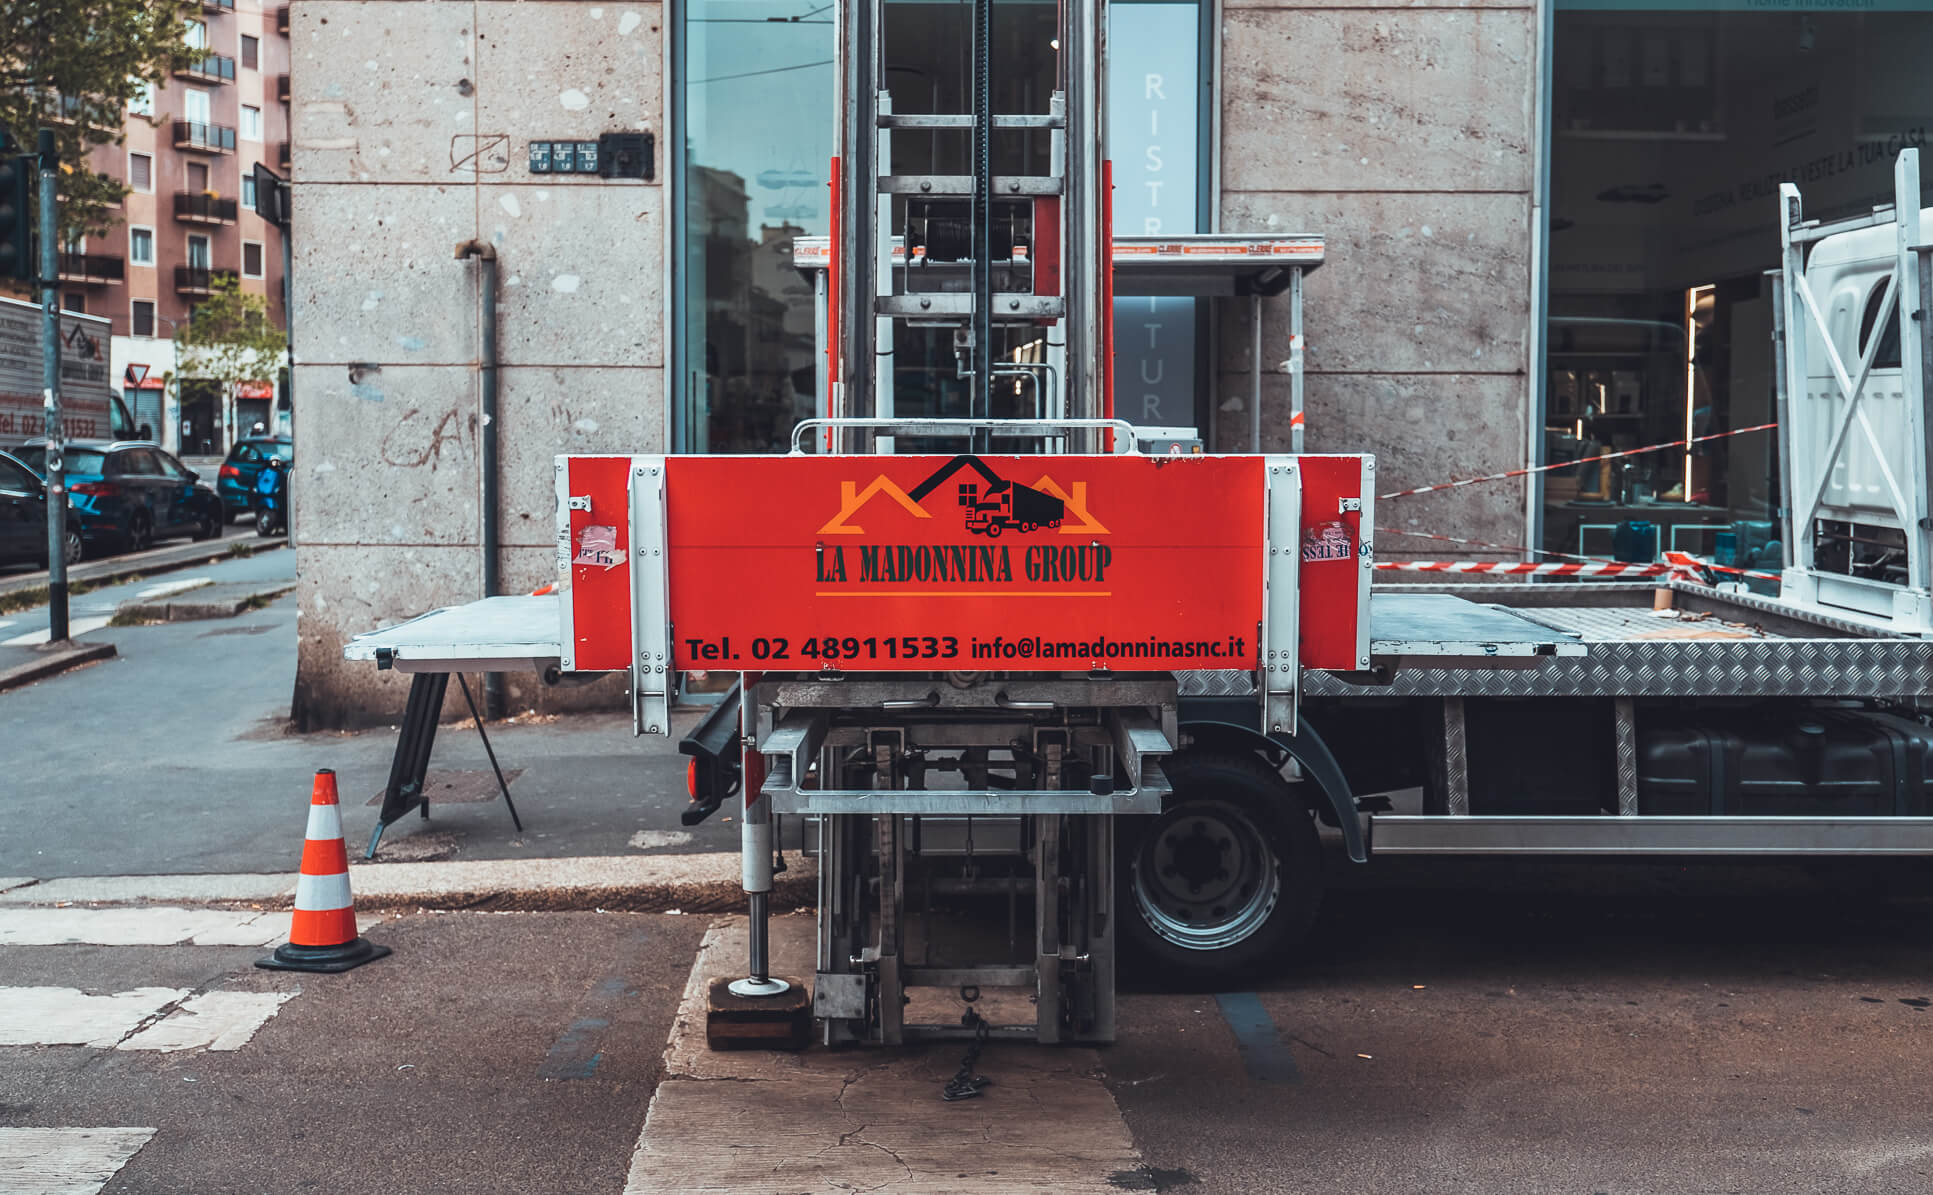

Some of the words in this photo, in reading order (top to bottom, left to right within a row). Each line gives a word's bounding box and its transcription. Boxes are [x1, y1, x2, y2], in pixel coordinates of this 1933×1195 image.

[1838, 150, 1855, 172] LA
[1857, 141, 1885, 166] TUA
[40, 416, 96, 439] 11533
[815, 545, 847, 582] LA
[859, 545, 1013, 582] MADONNINA
[1025, 545, 1112, 582] GROUP
[685, 637, 740, 660] Tel.
[751, 638, 790, 660] 02
[800, 636, 959, 660] 48911533
[971, 635, 1245, 659] info@lamadonninasnc.it
